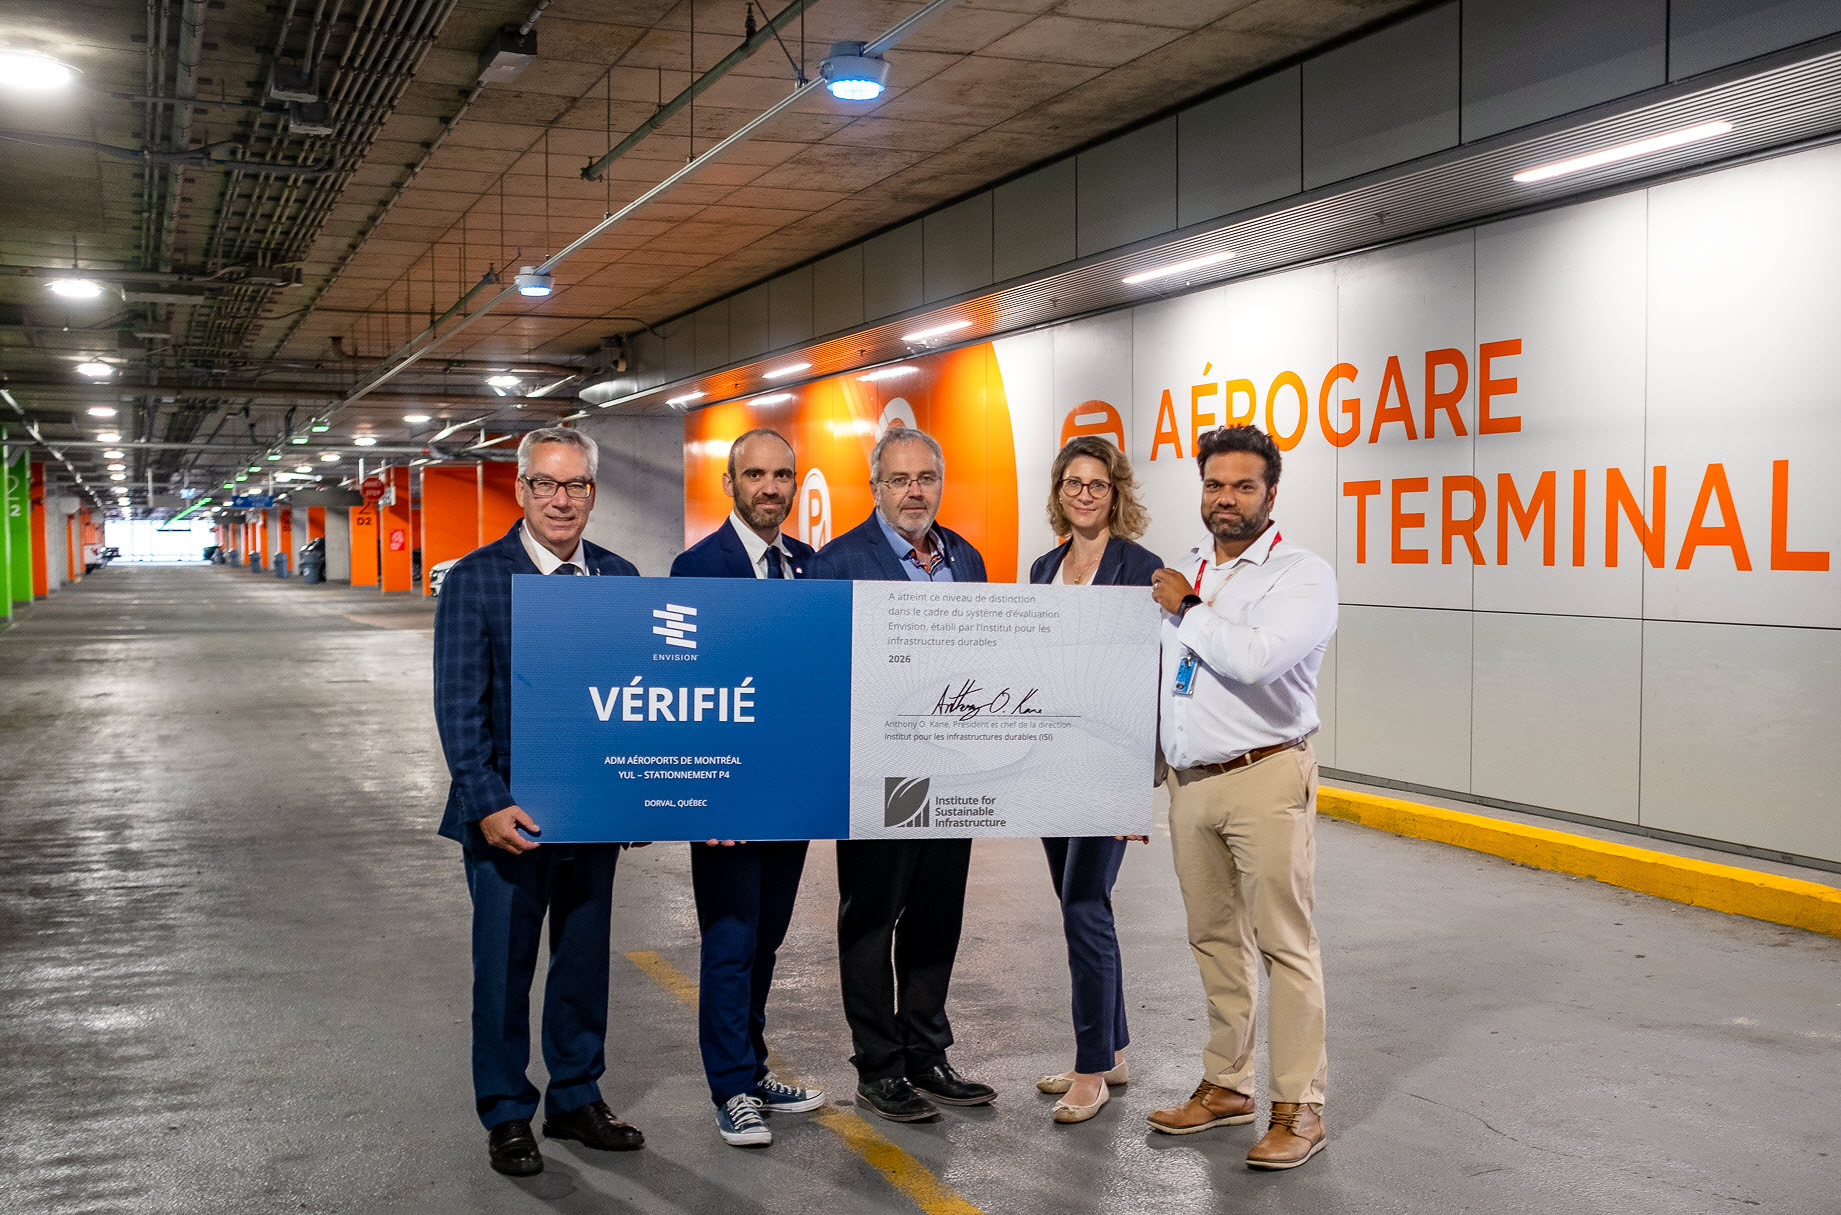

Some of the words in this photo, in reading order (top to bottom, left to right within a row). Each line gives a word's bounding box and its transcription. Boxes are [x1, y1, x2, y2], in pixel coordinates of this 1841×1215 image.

[1150, 338, 1522, 461] AÉROGARE
[1343, 459, 1830, 572] TERMINAL
[357, 517, 372, 526] D2
[889, 592, 896, 601] A
[898, 593, 927, 602] atteint
[943, 594, 972, 603] niveau
[975, 594, 986, 603] de
[989, 595, 1036, 604] distinction
[889, 608, 910, 616] dans
[923, 608, 949, 617] cadre
[951, 609, 963, 617] du
[1005, 609, 1060, 619] d'évaluation
[888, 622, 929, 632] Envision,
[931, 623, 956, 632] établi
[958, 625, 974, 634] par
[1014, 626, 1035, 634] pour
[1038, 625, 1051, 633] les
[887, 637, 955, 646] infrastructures
[958, 638, 997, 647] durables
[888, 655, 911, 664] 2026
[588, 676, 756, 723] VÉRIFIÉ
[1011, 688, 1042, 714] Kane
[884, 721, 917, 730] Anthony
[930, 721, 951, 730] Kane,
[1001, 721, 1017, 729] chef
[1018, 721, 1028, 729] de
[1030, 721, 1036, 729] la
[1038, 721, 1071, 729] direction
[884, 733, 912, 741] Institut
[914, 734, 932, 742] pour
[934, 733, 945, 741] les
[946, 733, 1003, 741] infrastructures
[1004, 733, 1037, 741] durables
[1038, 733, 1053, 742] (ISI)
[604, 757, 626, 765] ADM
[627, 755, 679, 765] AÉROPORTS
[681, 757, 692, 765] DE
[694, 755, 742, 765] MONTRÉAL
[618, 771, 636, 779] YUL
[644, 771, 717, 779] STATIONNEMENT
[719, 771, 730, 779] P4
[644, 800, 676, 808] DORVAL,
[677, 798, 708, 808] QUÉBEC
[935, 796, 979, 805] Institute
[981, 796, 996, 805] for
[935, 807, 994, 816] Sustainable
[935, 818, 1006, 828] Infrastructure
